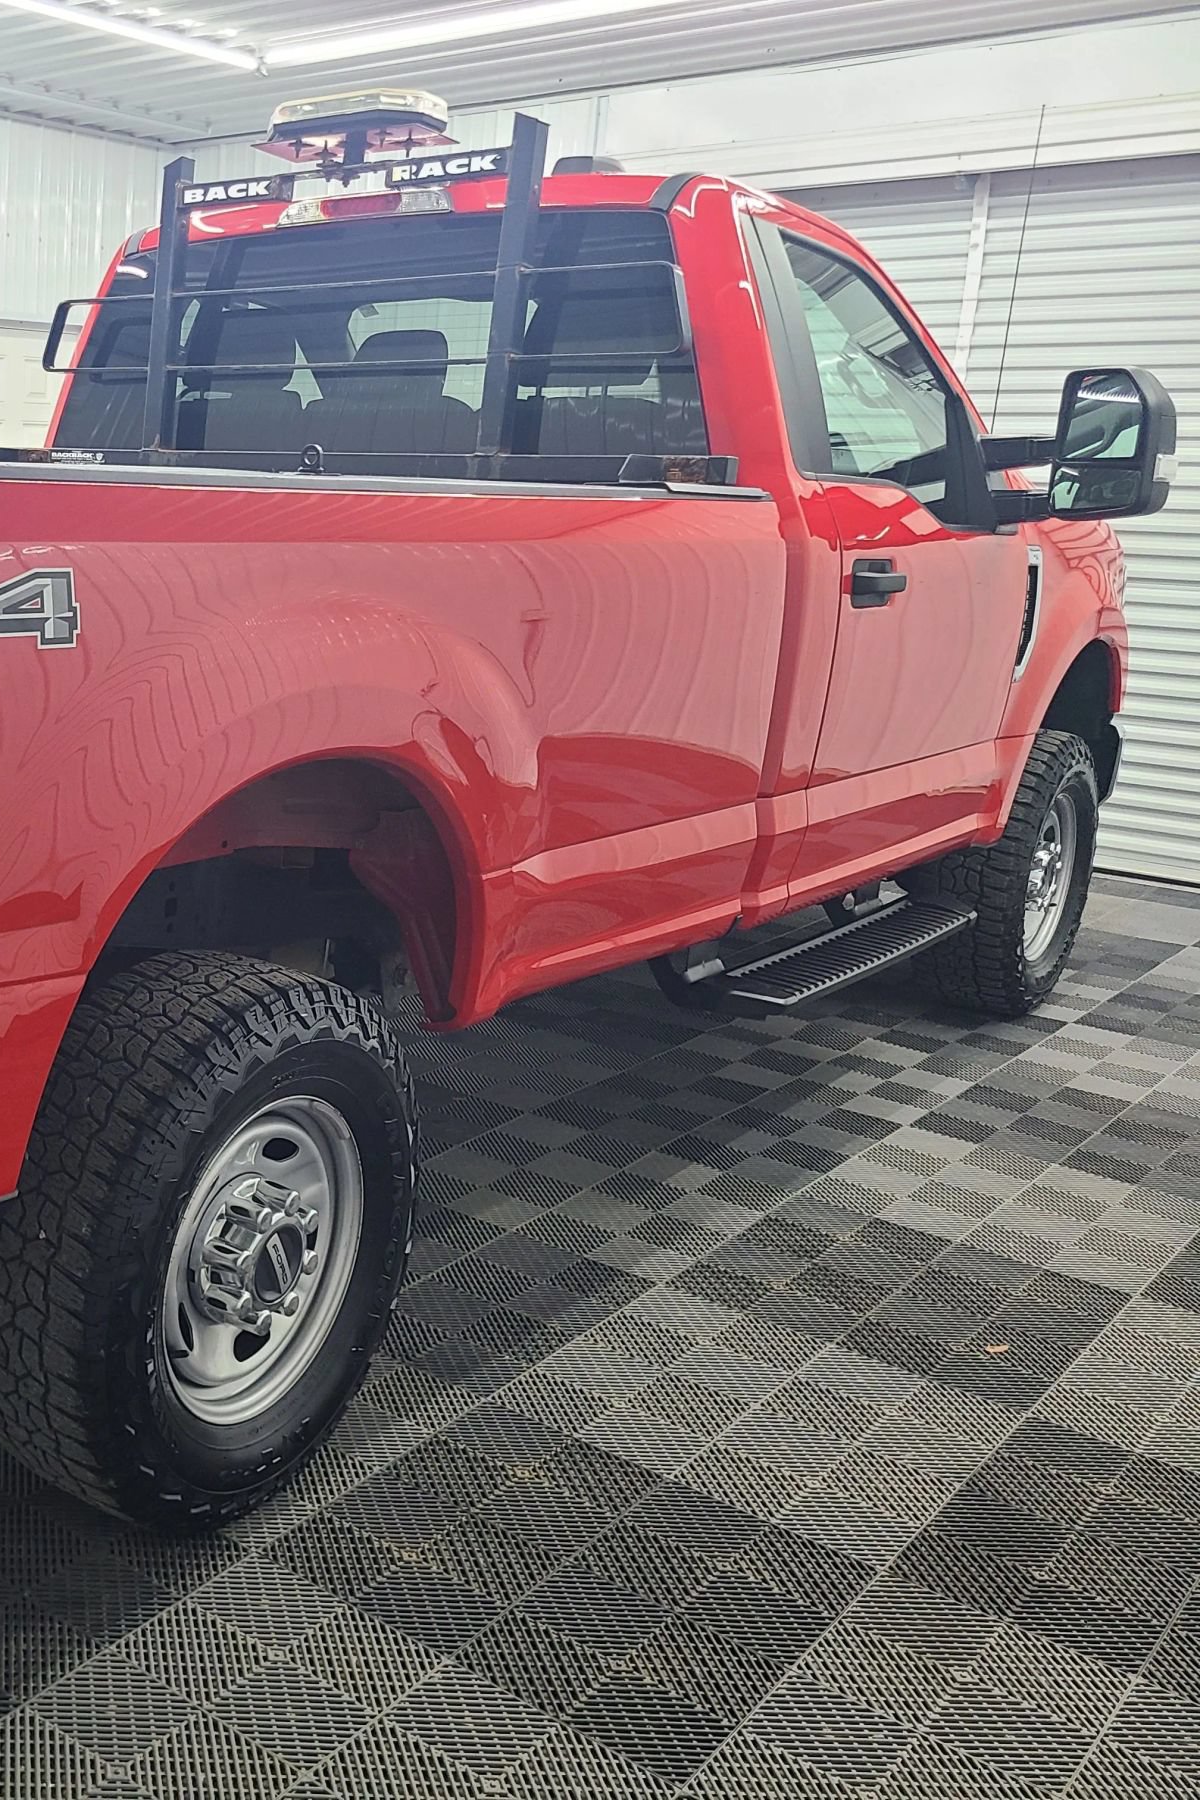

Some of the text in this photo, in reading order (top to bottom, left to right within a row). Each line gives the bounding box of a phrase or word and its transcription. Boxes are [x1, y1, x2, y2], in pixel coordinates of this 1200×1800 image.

[183, 153, 499, 205] BACK RACK
[272, 1243, 288, 1285] FORD
